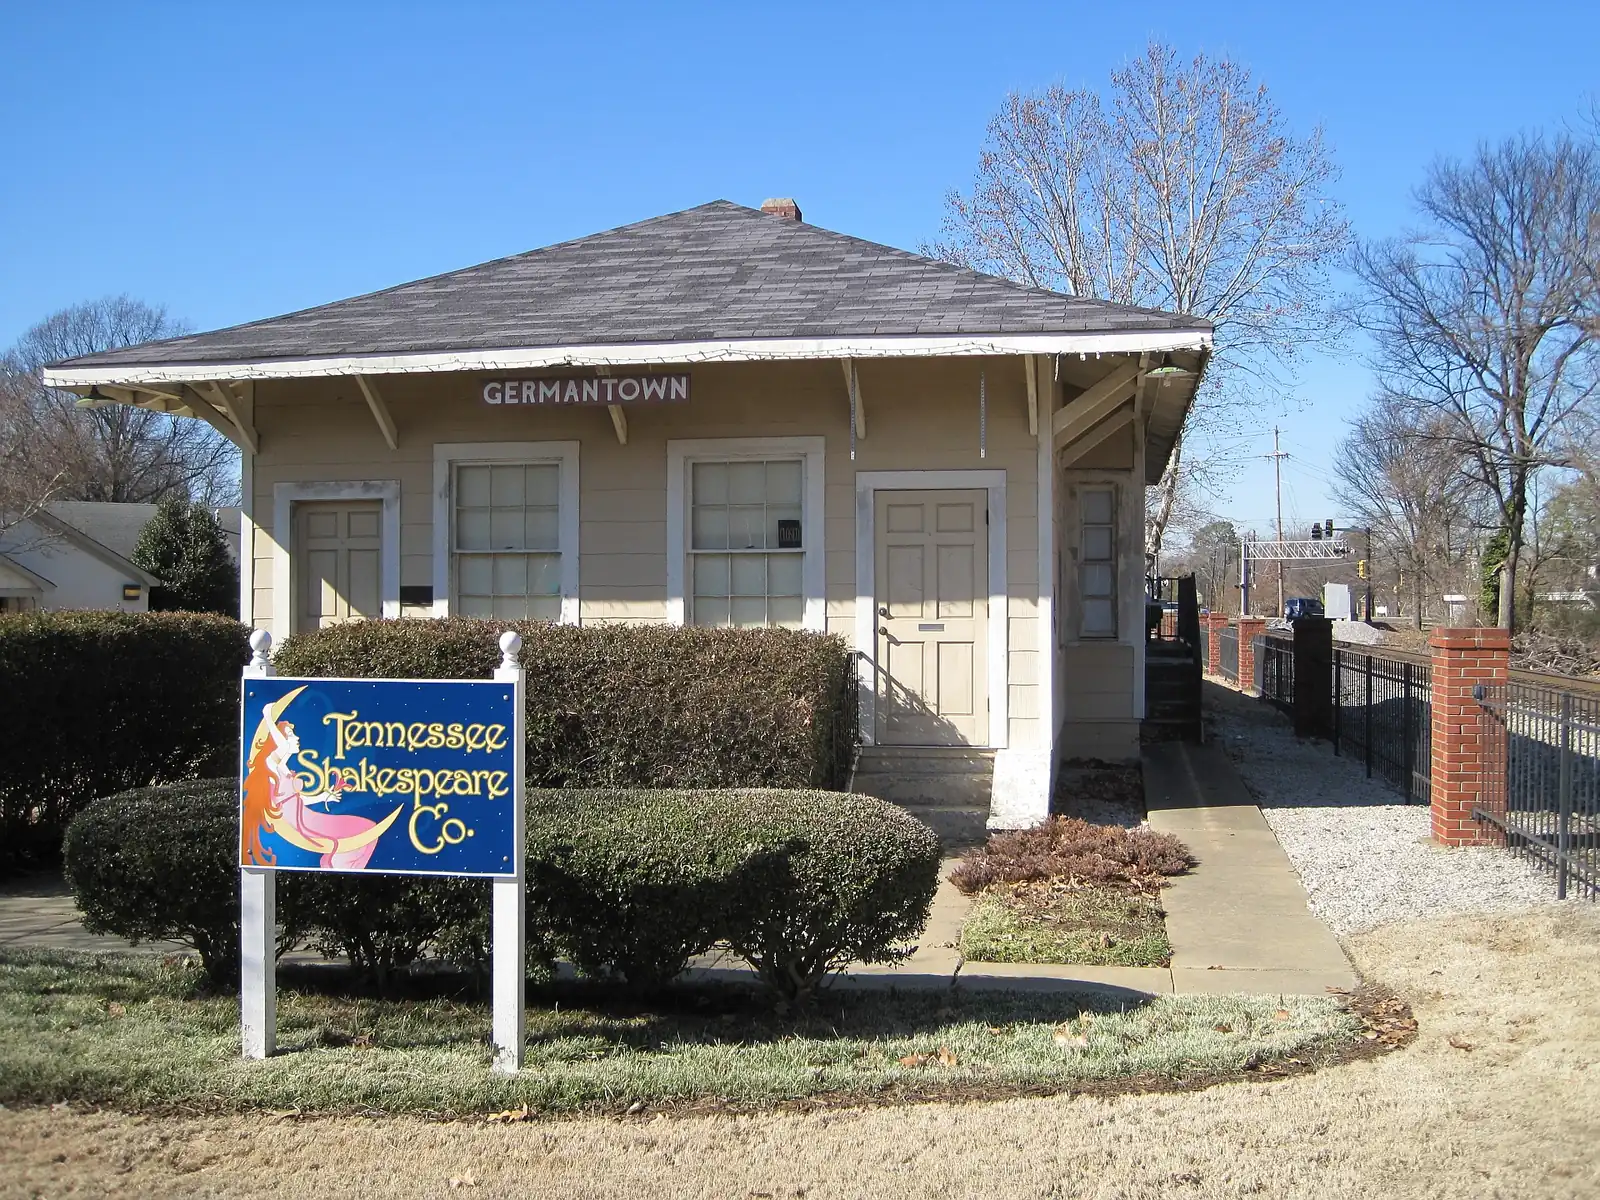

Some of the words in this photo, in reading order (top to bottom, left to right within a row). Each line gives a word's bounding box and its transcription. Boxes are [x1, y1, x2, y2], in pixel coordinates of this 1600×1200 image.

[483, 376, 688, 404] GERMANTOWN
[322, 710, 509, 759] Tennessee
[293, 749, 510, 809] Shakespeare
[408, 803, 475, 855] Co.
